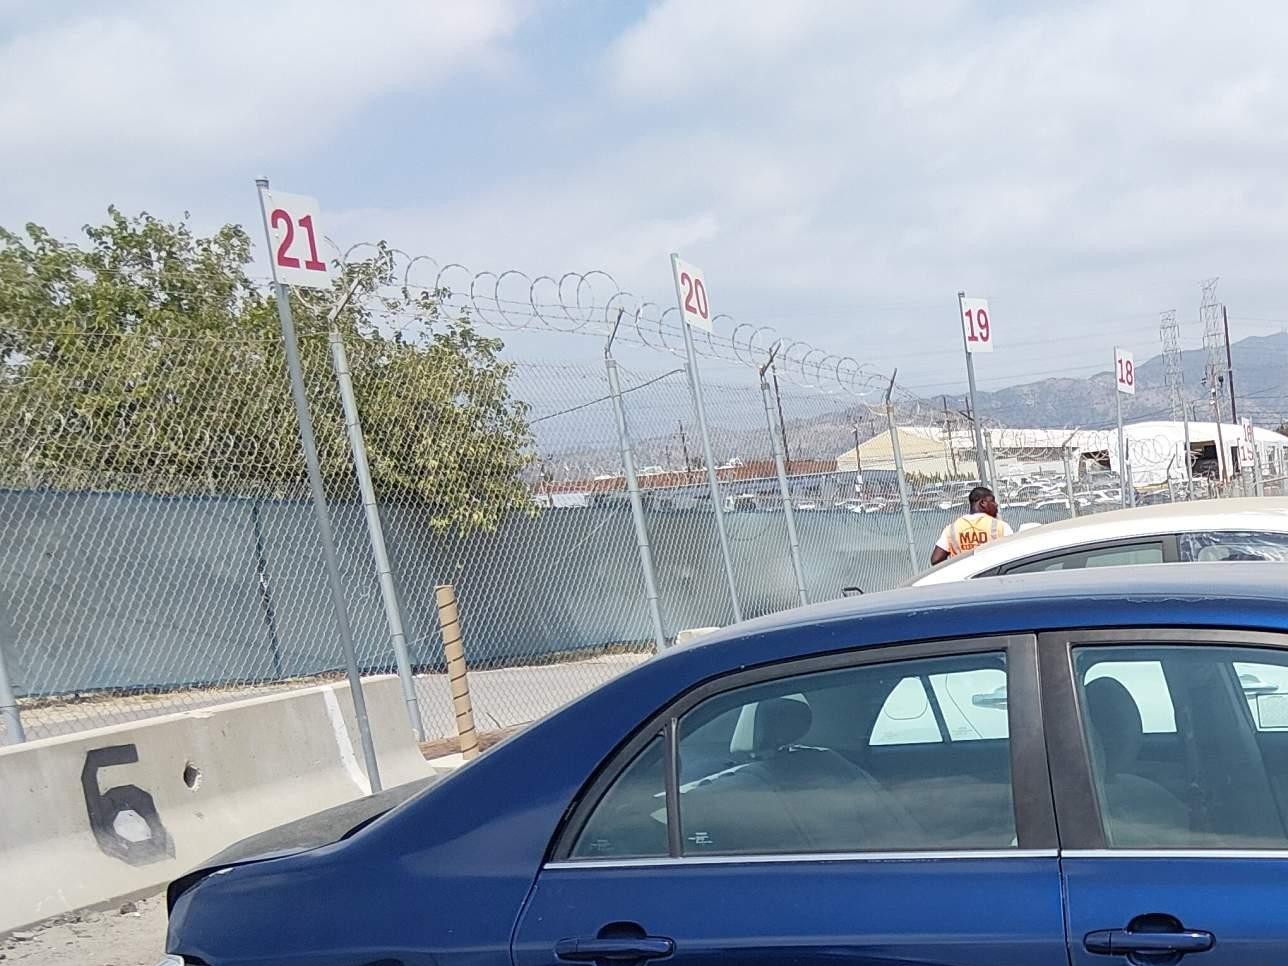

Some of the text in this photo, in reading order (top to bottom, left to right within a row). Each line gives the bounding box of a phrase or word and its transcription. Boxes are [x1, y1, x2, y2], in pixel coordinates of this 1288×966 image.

[270, 208, 327, 272] 21
[680, 272, 709, 319] 20
[965, 308, 990, 342] 19
[1118, 358, 1134, 386] 18
[1240, 446, 1254, 461] 15
[959, 531, 988, 545] MAD
[81, 743, 176, 867] 6
